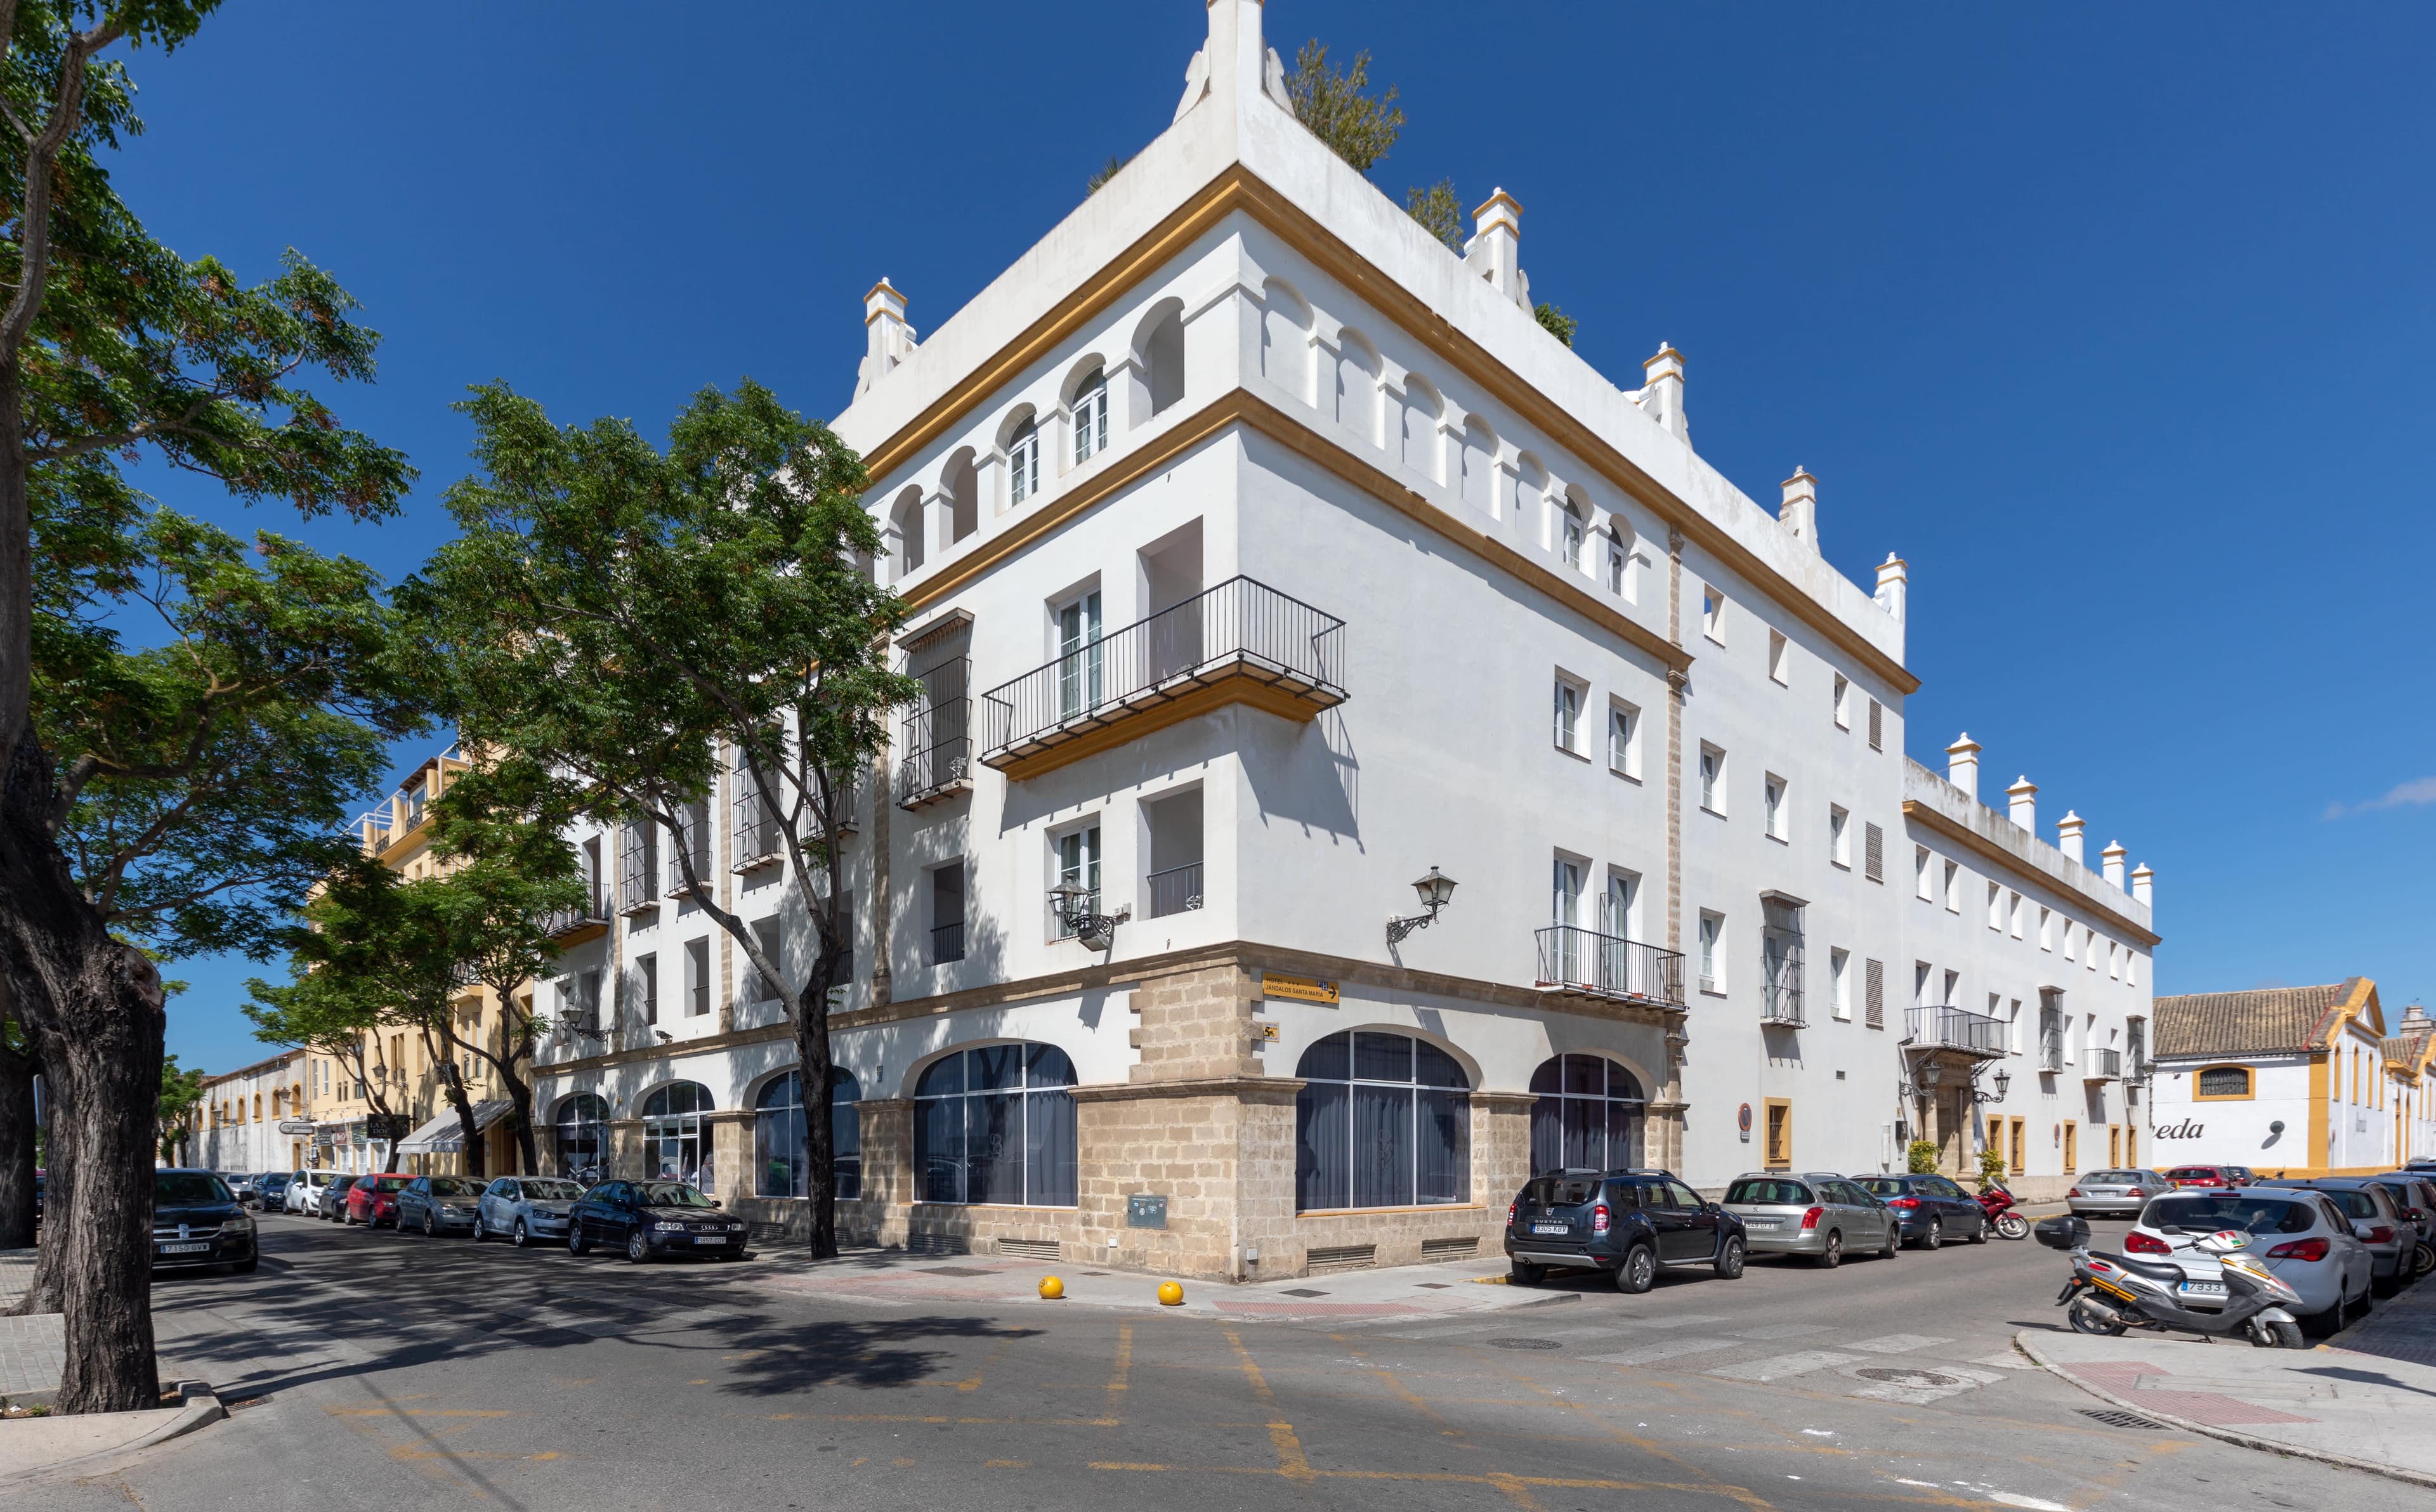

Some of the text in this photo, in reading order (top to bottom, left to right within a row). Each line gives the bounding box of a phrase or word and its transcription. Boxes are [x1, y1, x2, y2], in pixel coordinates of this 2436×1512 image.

[1266, 977, 1284, 985] HOTEL
[1266, 984, 1292, 993] JANDALOS
[1322, 982, 1328, 990] H
[2152, 1118, 2204, 1140] eda
[2189, 1282, 2221, 1292] 7933
